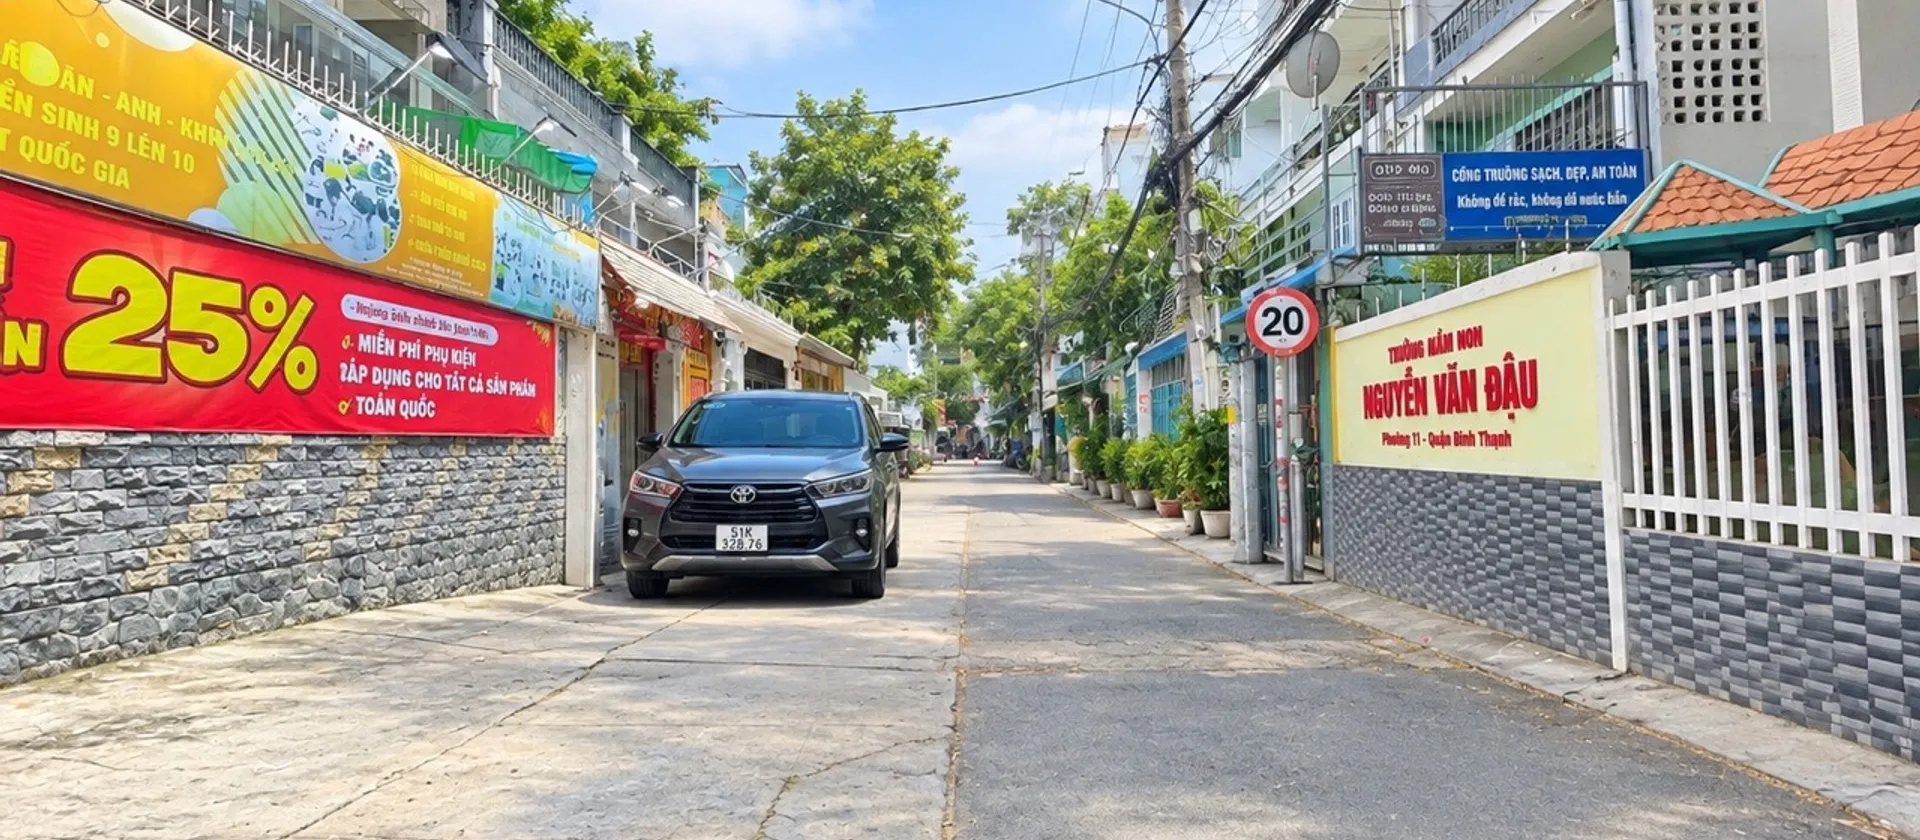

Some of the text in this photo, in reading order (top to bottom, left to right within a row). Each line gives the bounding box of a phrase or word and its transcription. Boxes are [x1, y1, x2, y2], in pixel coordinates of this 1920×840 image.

[115, 91, 161, 126] ANH
[41, 101, 99, 141] SINH
[106, 125, 120, 147] 9
[172, 150, 195, 174] 10
[19, 141, 86, 175] QUỐC
[93, 160, 130, 190] GIA
[62, 252, 319, 392] 25%
[1262, 306, 1304, 337] 20
[372, 366, 411, 389] DỤNG
[415, 371, 442, 391] CHO
[1484, 351, 1539, 420] ĐẬU
[400, 393, 435, 420] QUỐC
[1412, 432, 1420, 446] 11
